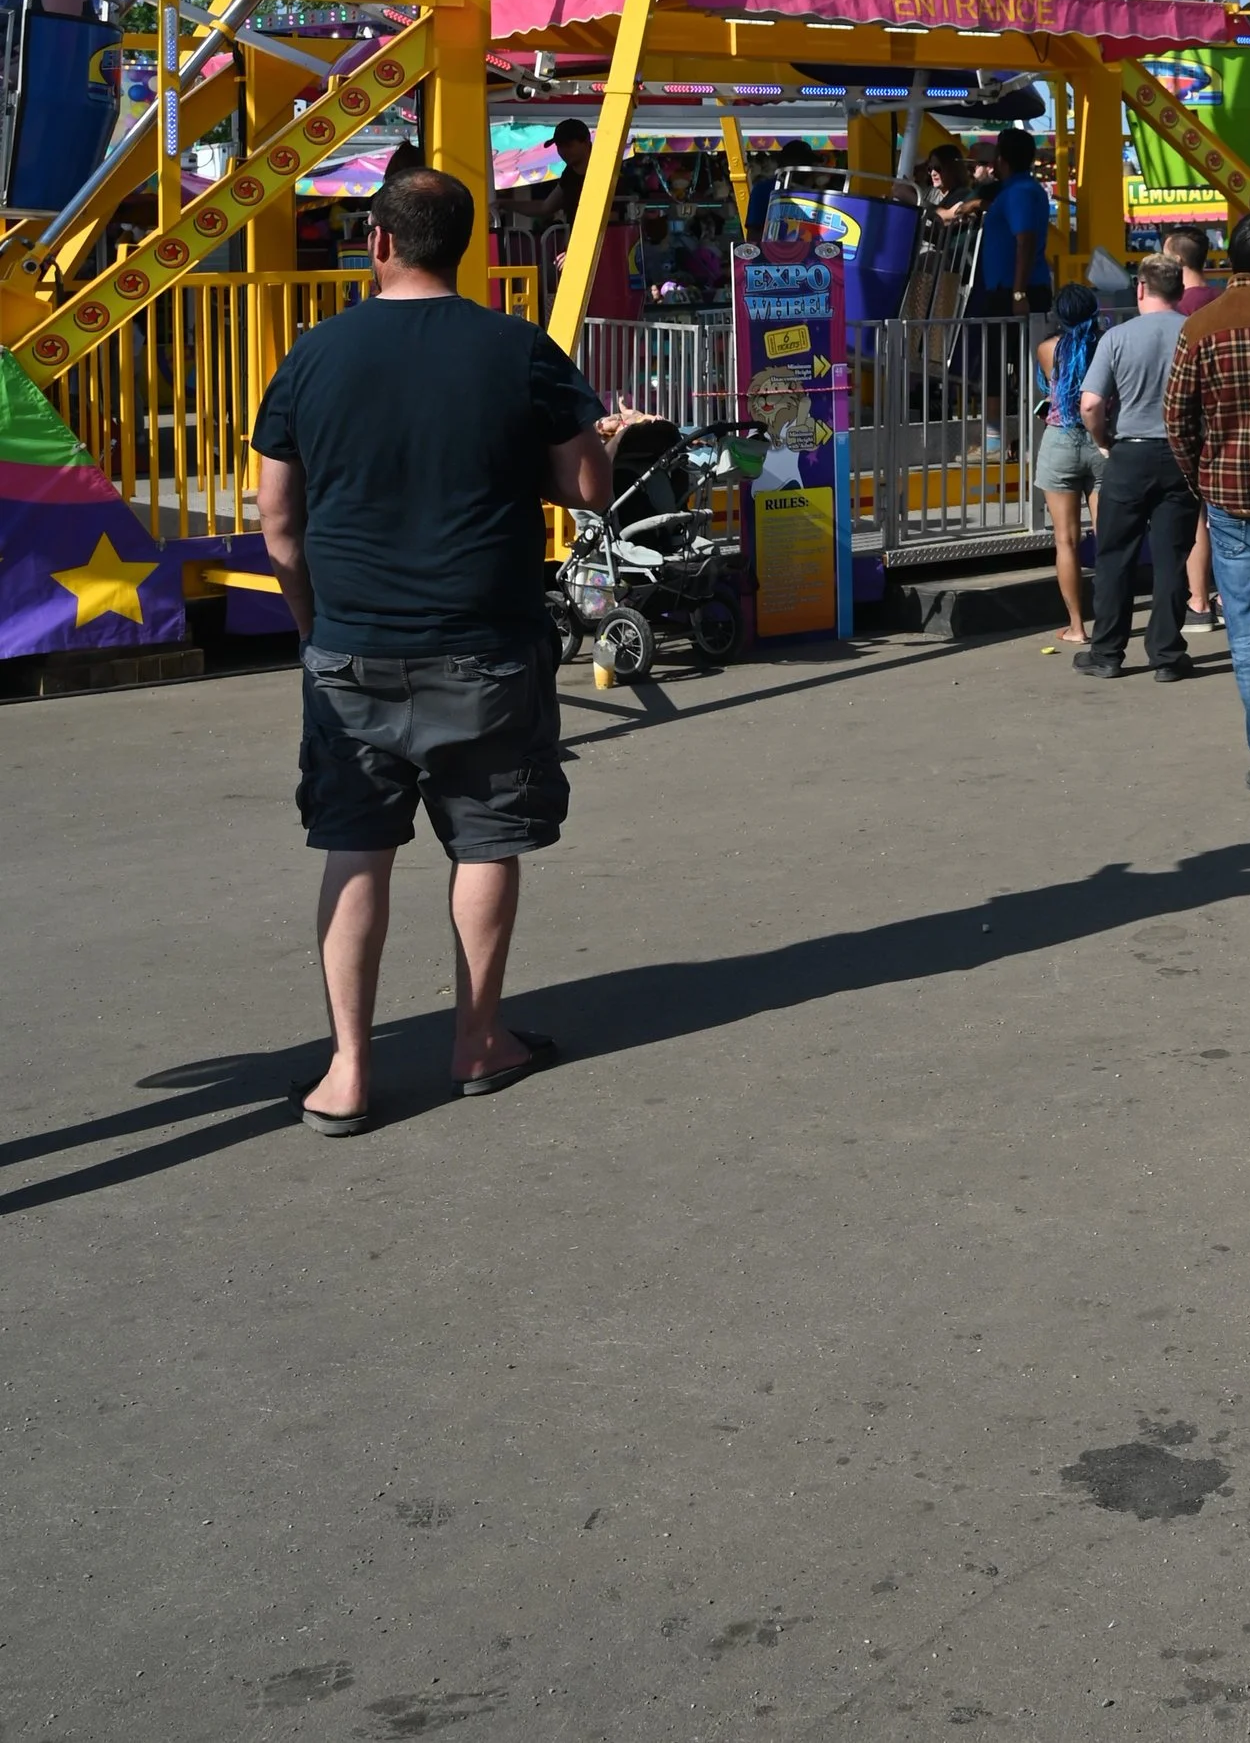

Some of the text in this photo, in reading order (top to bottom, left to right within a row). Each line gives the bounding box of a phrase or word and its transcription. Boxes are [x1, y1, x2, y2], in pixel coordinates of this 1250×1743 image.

[744, 263, 832, 293] EXPO
[744, 293, 834, 321] WHEEL
[765, 496, 809, 511] RULES:
